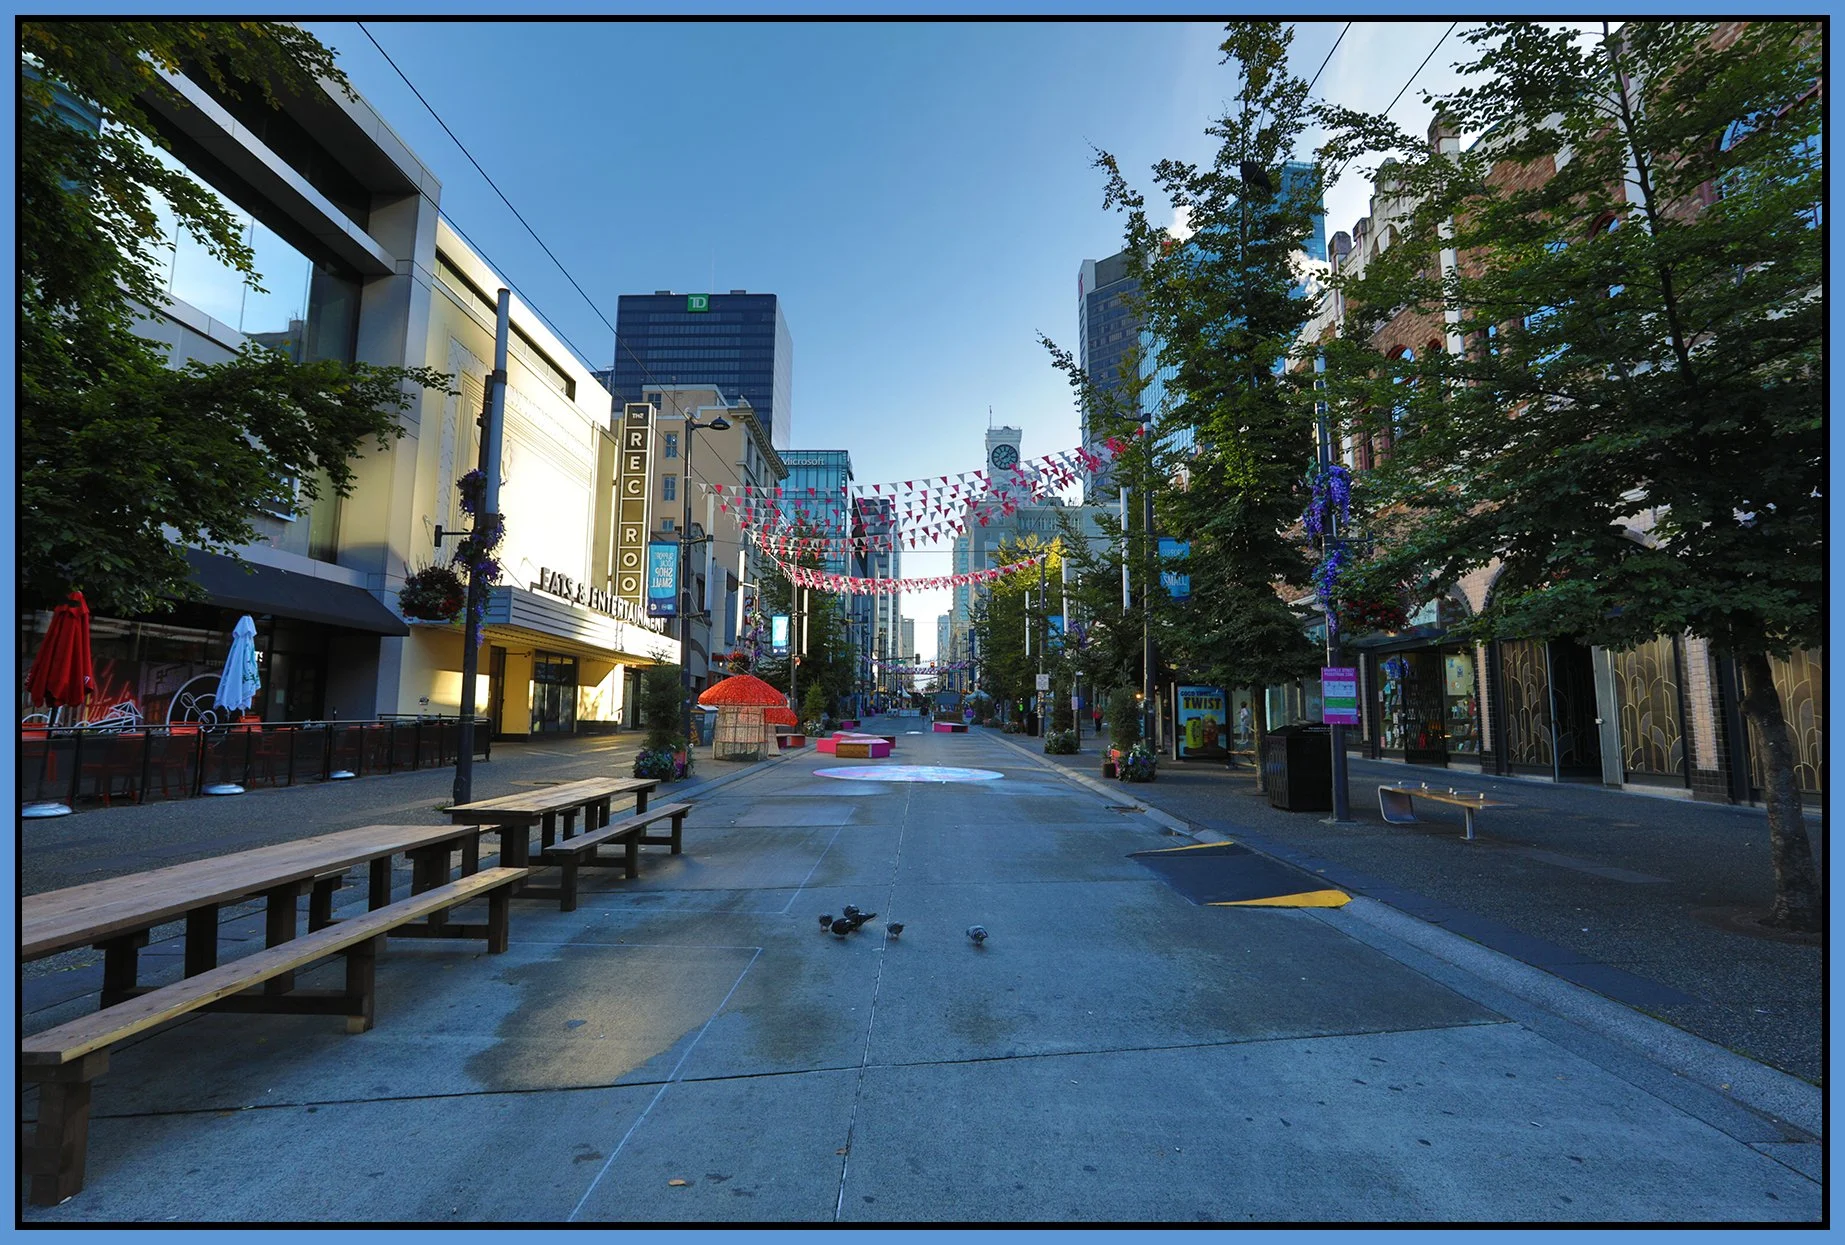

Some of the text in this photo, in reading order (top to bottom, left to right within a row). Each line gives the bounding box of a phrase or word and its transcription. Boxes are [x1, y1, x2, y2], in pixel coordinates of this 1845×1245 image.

[690, 297, 707, 308] TD
[627, 432, 642, 494] REC
[783, 456, 825, 466] Microsoft
[621, 528, 638, 592] ROO
[540, 567, 575, 600] EATS
[578, 583, 587, 604] &
[1184, 697, 1221, 709] TWIST
